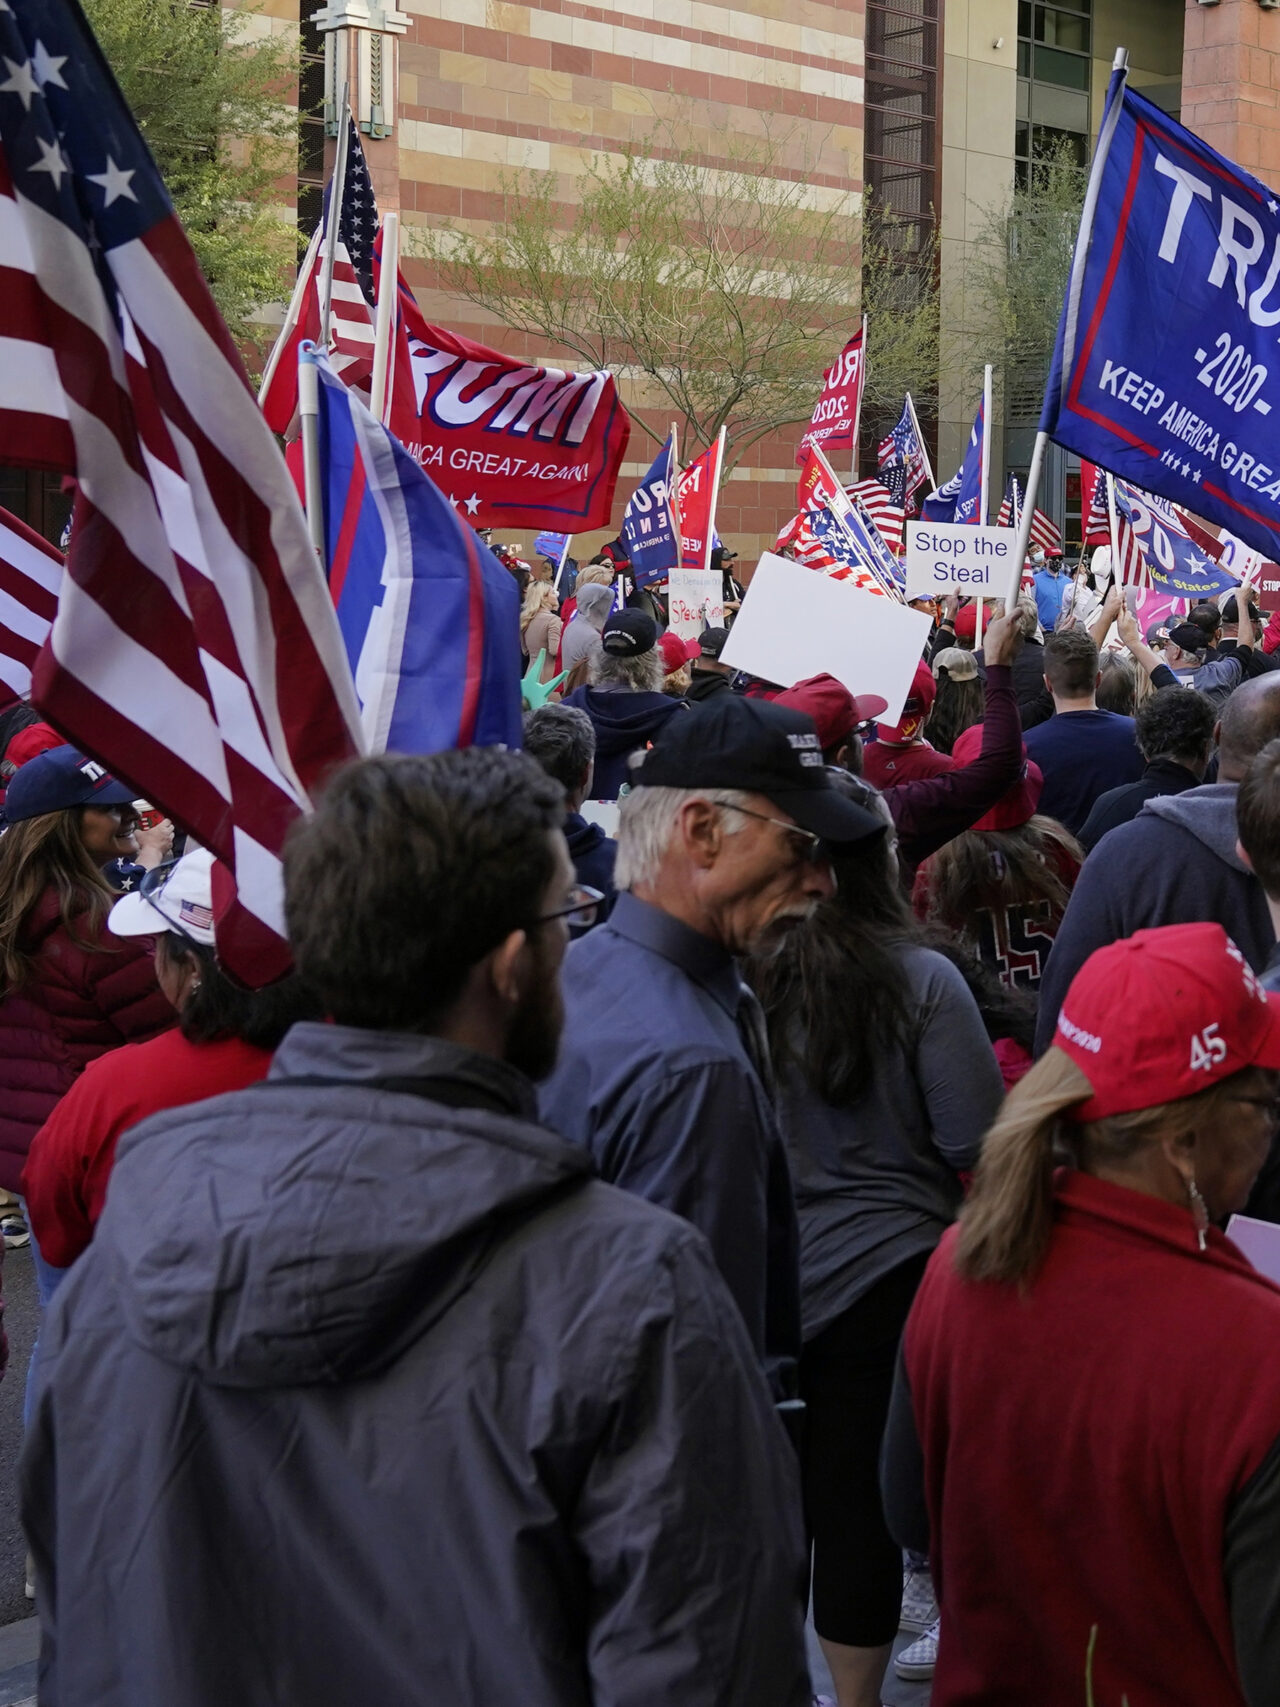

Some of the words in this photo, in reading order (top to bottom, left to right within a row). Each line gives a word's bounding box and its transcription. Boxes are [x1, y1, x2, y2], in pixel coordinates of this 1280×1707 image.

[1099, 360, 1165, 416] KEEP
[1158, 401, 1220, 461] AMERICA
[450, 449, 527, 476] GREAT
[916, 532, 966, 558] Stop
[974, 536, 1008, 557] the
[933, 561, 990, 584] Steal
[1173, 579, 1221, 593] States
[1190, 1022, 1227, 1071] 45
